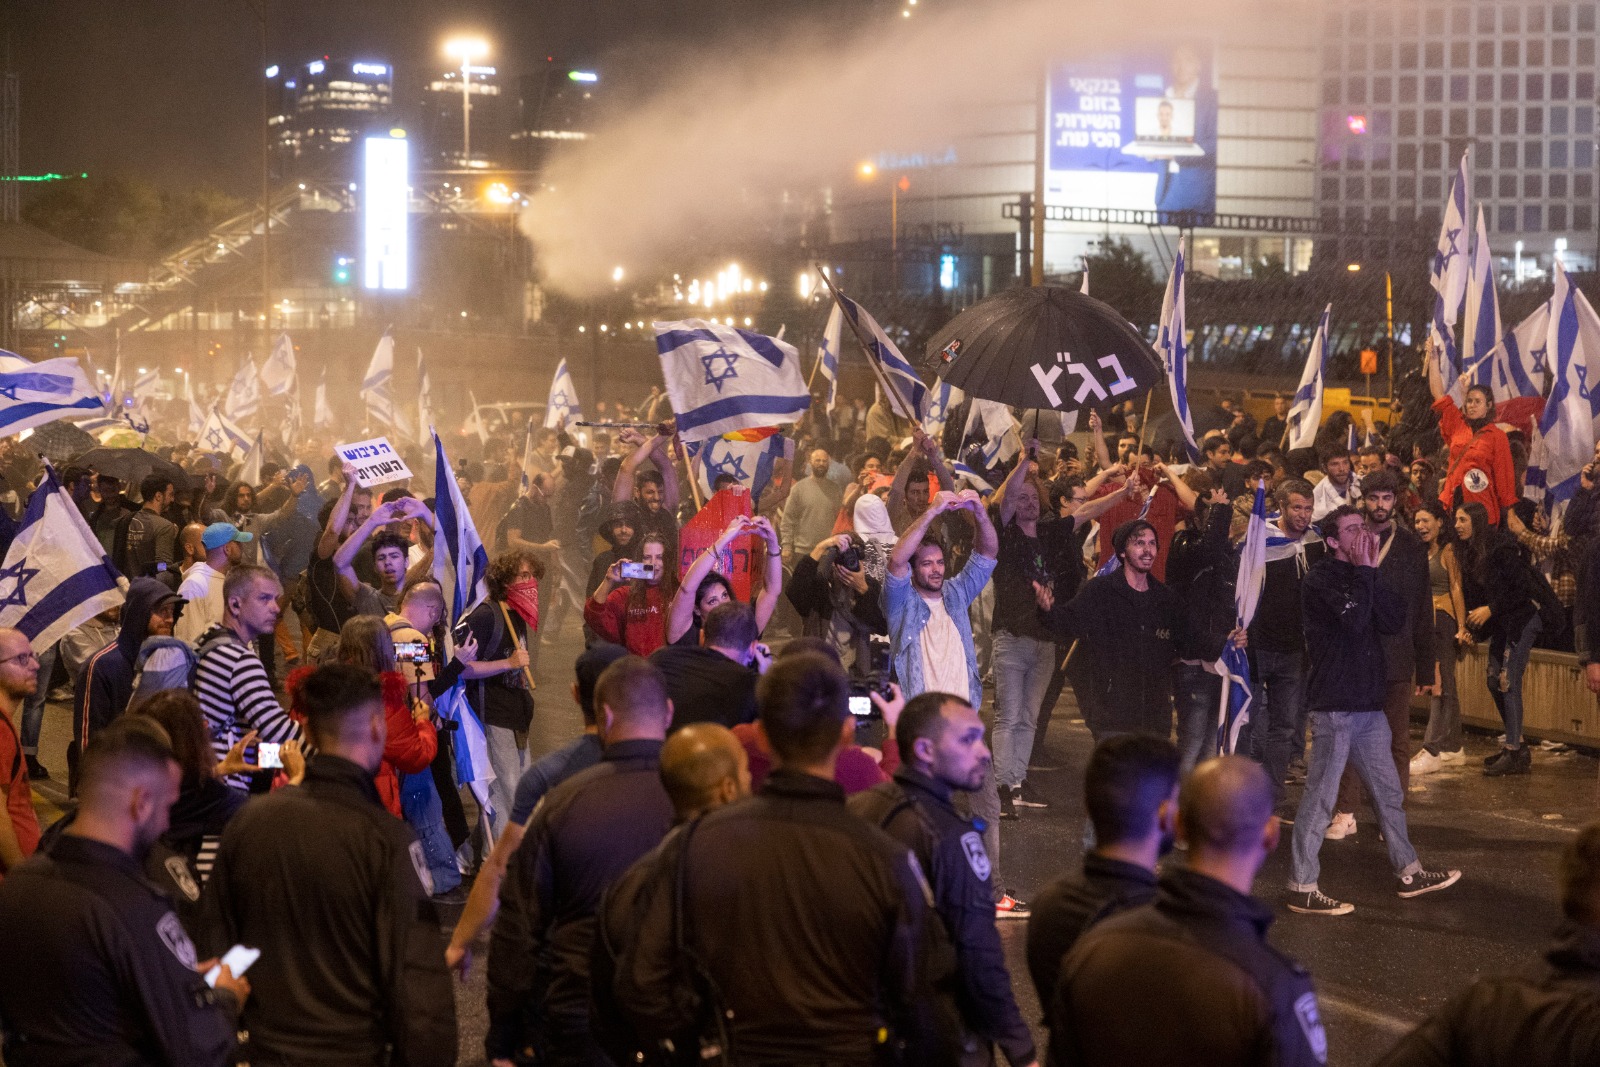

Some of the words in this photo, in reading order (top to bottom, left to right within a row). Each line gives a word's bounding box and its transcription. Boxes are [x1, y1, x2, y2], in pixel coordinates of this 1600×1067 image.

[1079, 96, 1121, 112] בזום
[1055, 112, 1121, 130] השירות
[357, 460, 404, 480] השחית
